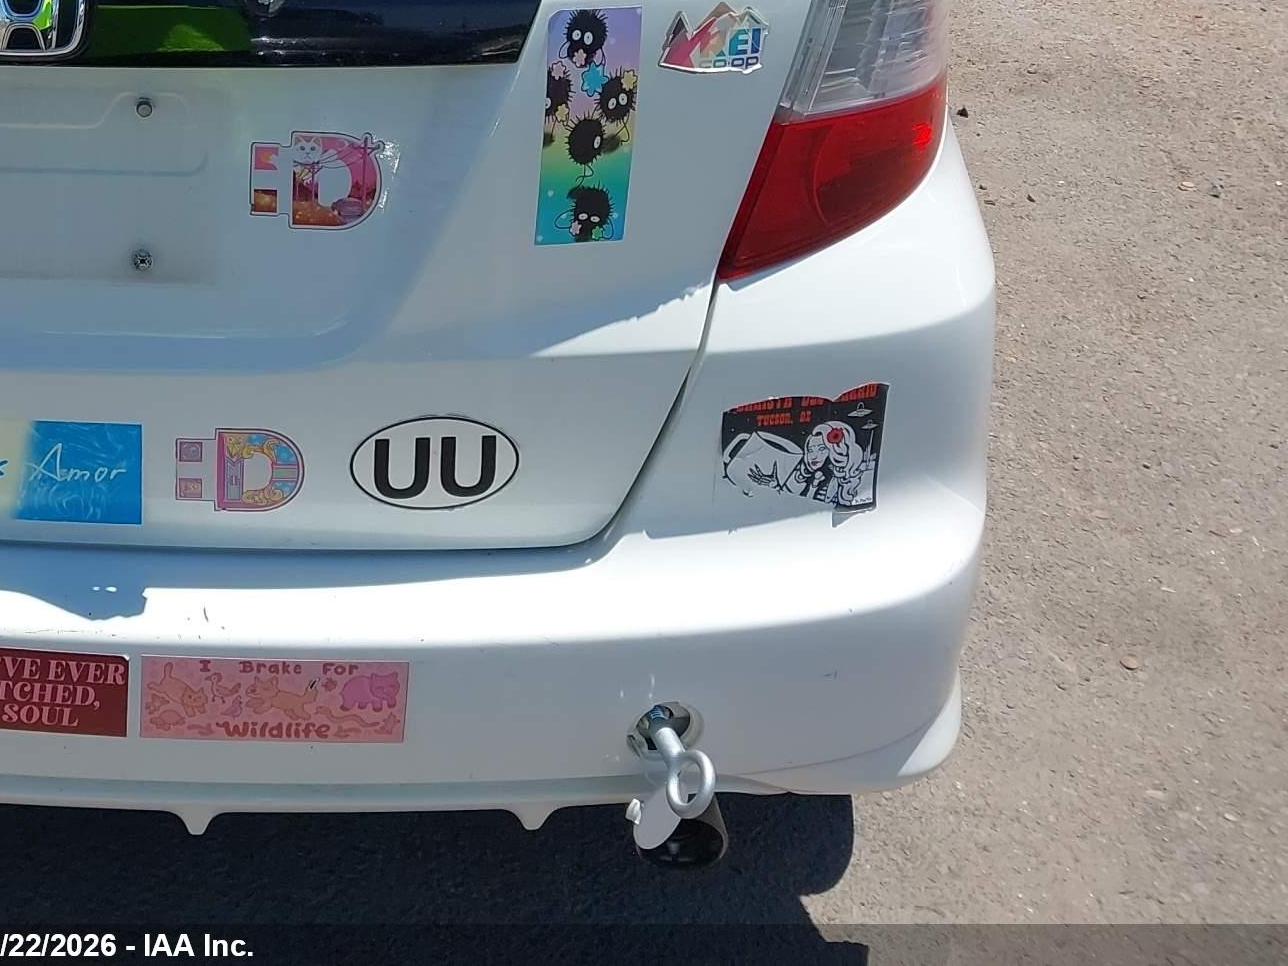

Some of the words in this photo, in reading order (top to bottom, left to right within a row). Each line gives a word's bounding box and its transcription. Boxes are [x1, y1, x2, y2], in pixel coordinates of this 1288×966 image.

[24, 442, 128, 482] Amor
[373, 434, 497, 499] UU
[47, 659, 126, 685] EVER
[239, 660, 303, 675] Brake
[322, 662, 360, 676] For
[1, 704, 79, 728] SOUL
[215, 721, 332, 740] Wildlife
